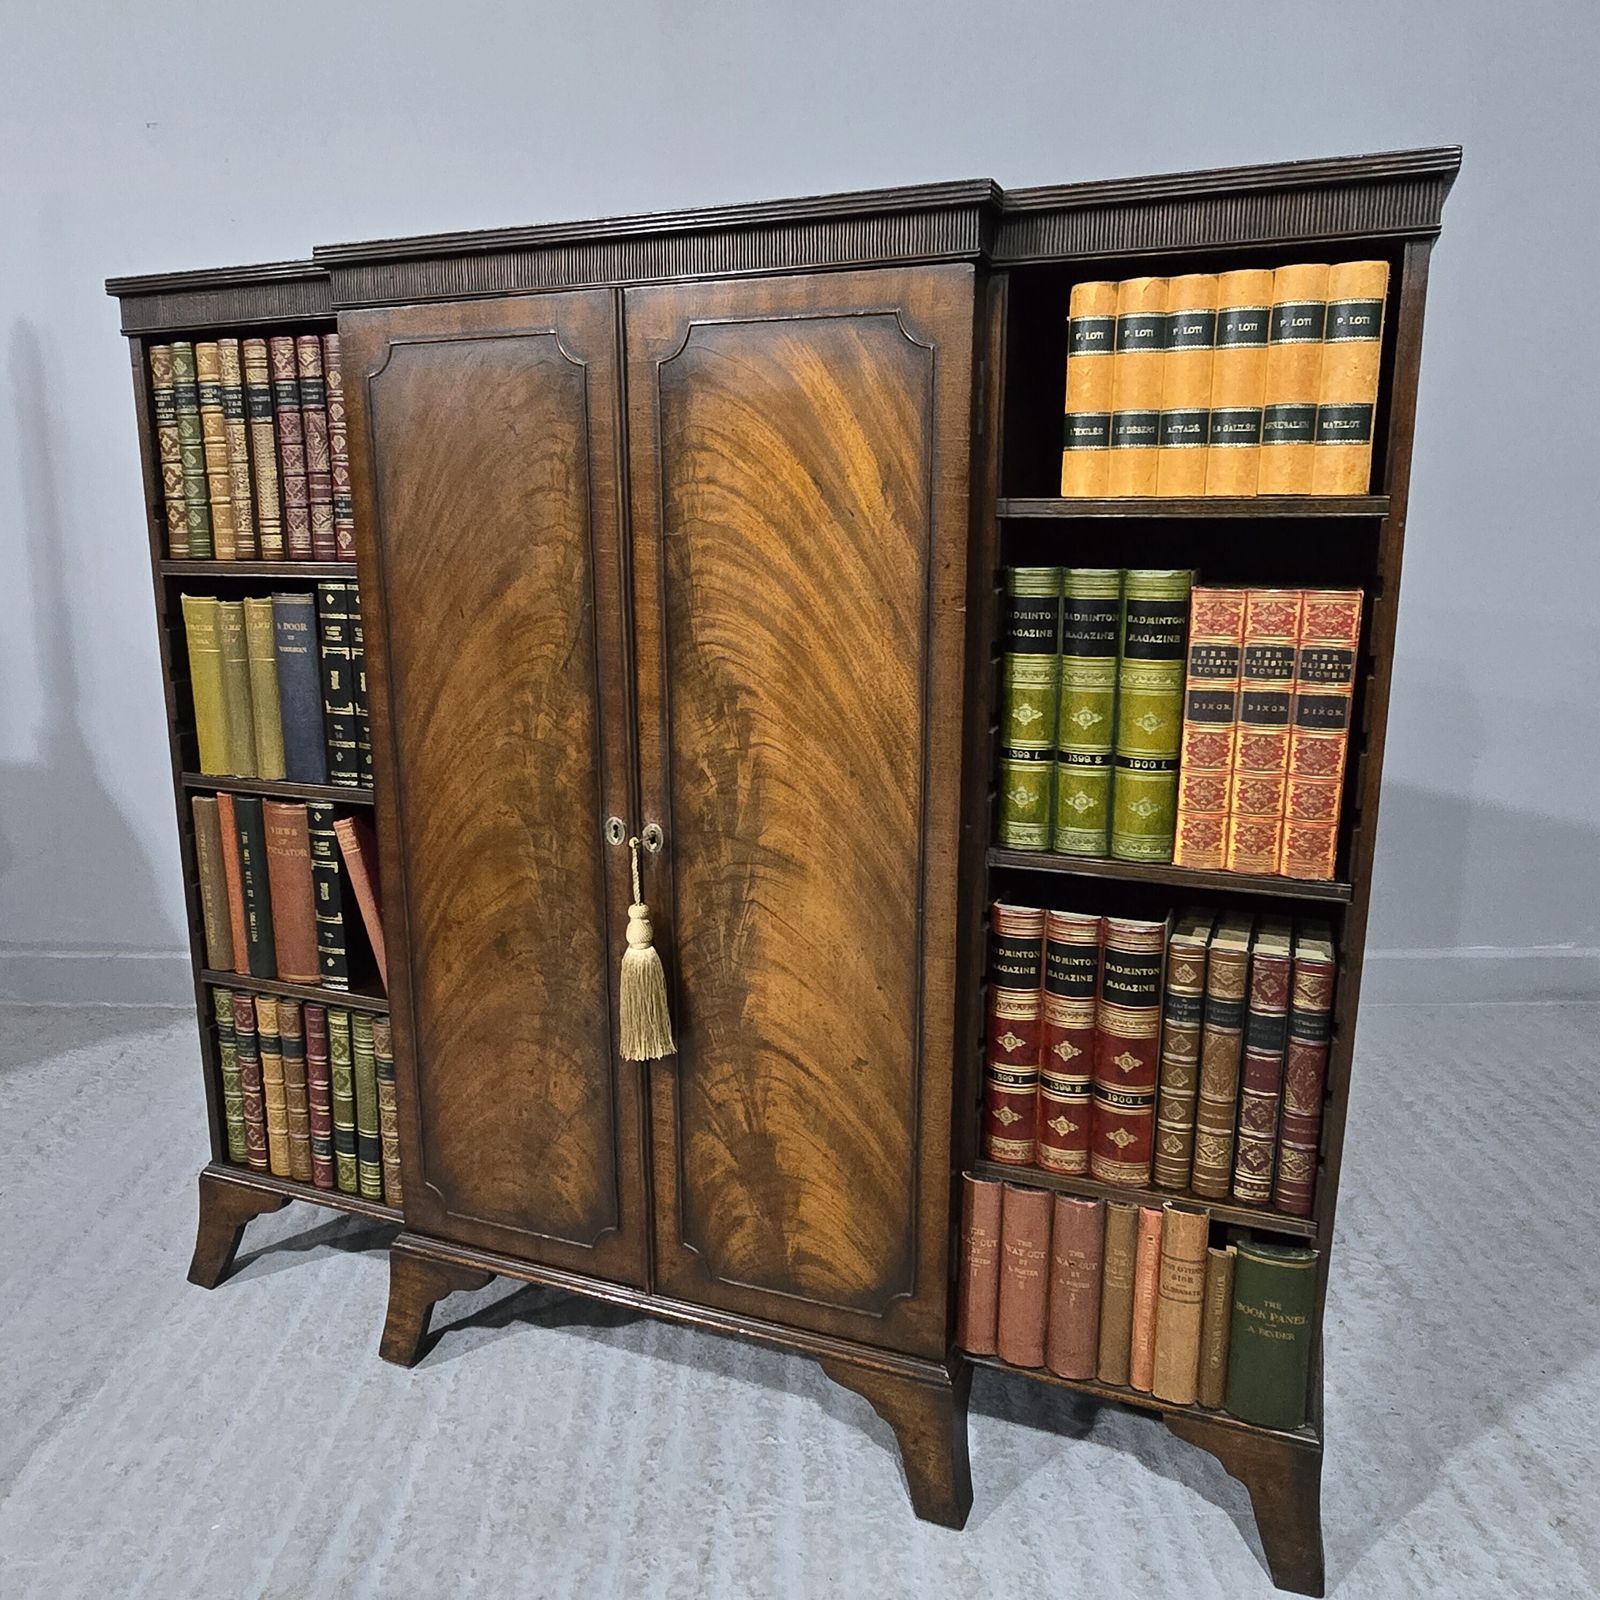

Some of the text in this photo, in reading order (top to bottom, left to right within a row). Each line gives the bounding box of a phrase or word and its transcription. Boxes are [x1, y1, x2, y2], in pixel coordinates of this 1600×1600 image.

[1291, 318, 1312, 326] LOTI
[1350, 316, 1370, 325] LOTI
[1183, 326, 1203, 335] LOTI
[1238, 323, 1258, 332] LOTI
[1085, 331, 1104, 340] LOTI
[1135, 329, 1154, 337] LOTI
[1127, 615, 1186, 625] BADMINTON
[283, 622, 308, 631] DOOR
[1128, 633, 1181, 643] MAGAZINE
[1194, 703, 1231, 711] DIXON
[1248, 704, 1287, 712] DIXON
[1303, 708, 1343, 716] DIXON
[1105, 961, 1160, 976] BADMINTON
[1047, 969, 1094, 982] MAGAZINE
[1106, 979, 1156, 993] MAGAZINE
[1263, 1300, 1282, 1311] THE
[1235, 1300, 1306, 1325] BOOK PANEL
[1247, 1325, 1256, 1334] A
